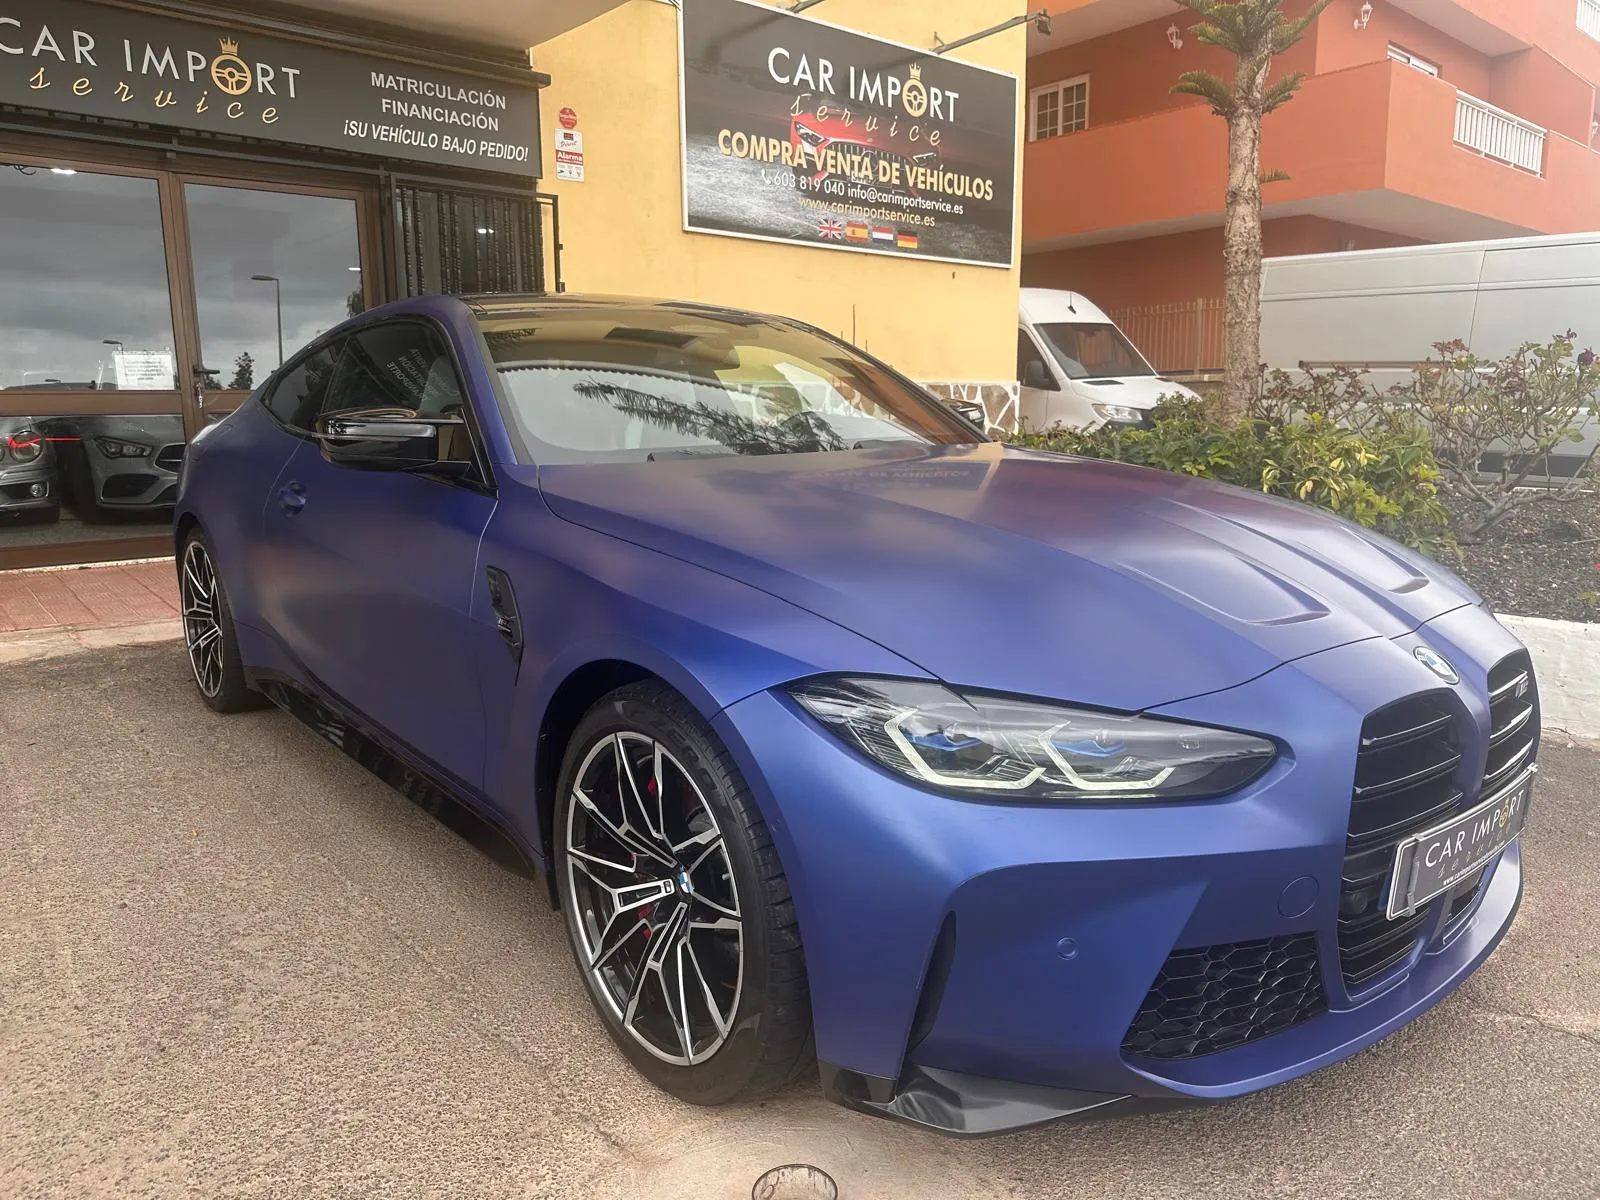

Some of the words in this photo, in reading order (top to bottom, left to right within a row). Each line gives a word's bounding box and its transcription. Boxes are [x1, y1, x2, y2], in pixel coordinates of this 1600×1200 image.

[0, 17, 98, 67] CAR
[124, 38, 301, 99] IMPORT
[29, 66, 279, 125] service
[371, 71, 506, 110] MATRICULACIÓN
[768, 47, 836, 95] CAR
[849, 65, 959, 123] IMPORT
[382, 98, 499, 131] FINANCIACIÓN
[790, 92, 942, 148] service
[344, 119, 368, 138] ¡SU
[372, 123, 438, 148] VEHÍCULO
[442, 135, 476, 155] BAJO
[479, 141, 529, 162] PEDIDO!
[557, 151, 583, 162] Alarma
[718, 129, 807, 169] COMPRA
[813, 147, 873, 181] VENTA
[879, 161, 901, 184] DE
[905, 164, 993, 201] VEHÍCULOS
[774, 172, 796, 188] 603
[800, 177, 821, 192] 819
[824, 181, 845, 196] 040
[847, 183, 964, 215] info@carimportservice.es
[800, 199, 936, 228] www.carimportservice.es
[1425, 830, 1466, 868] CAR
